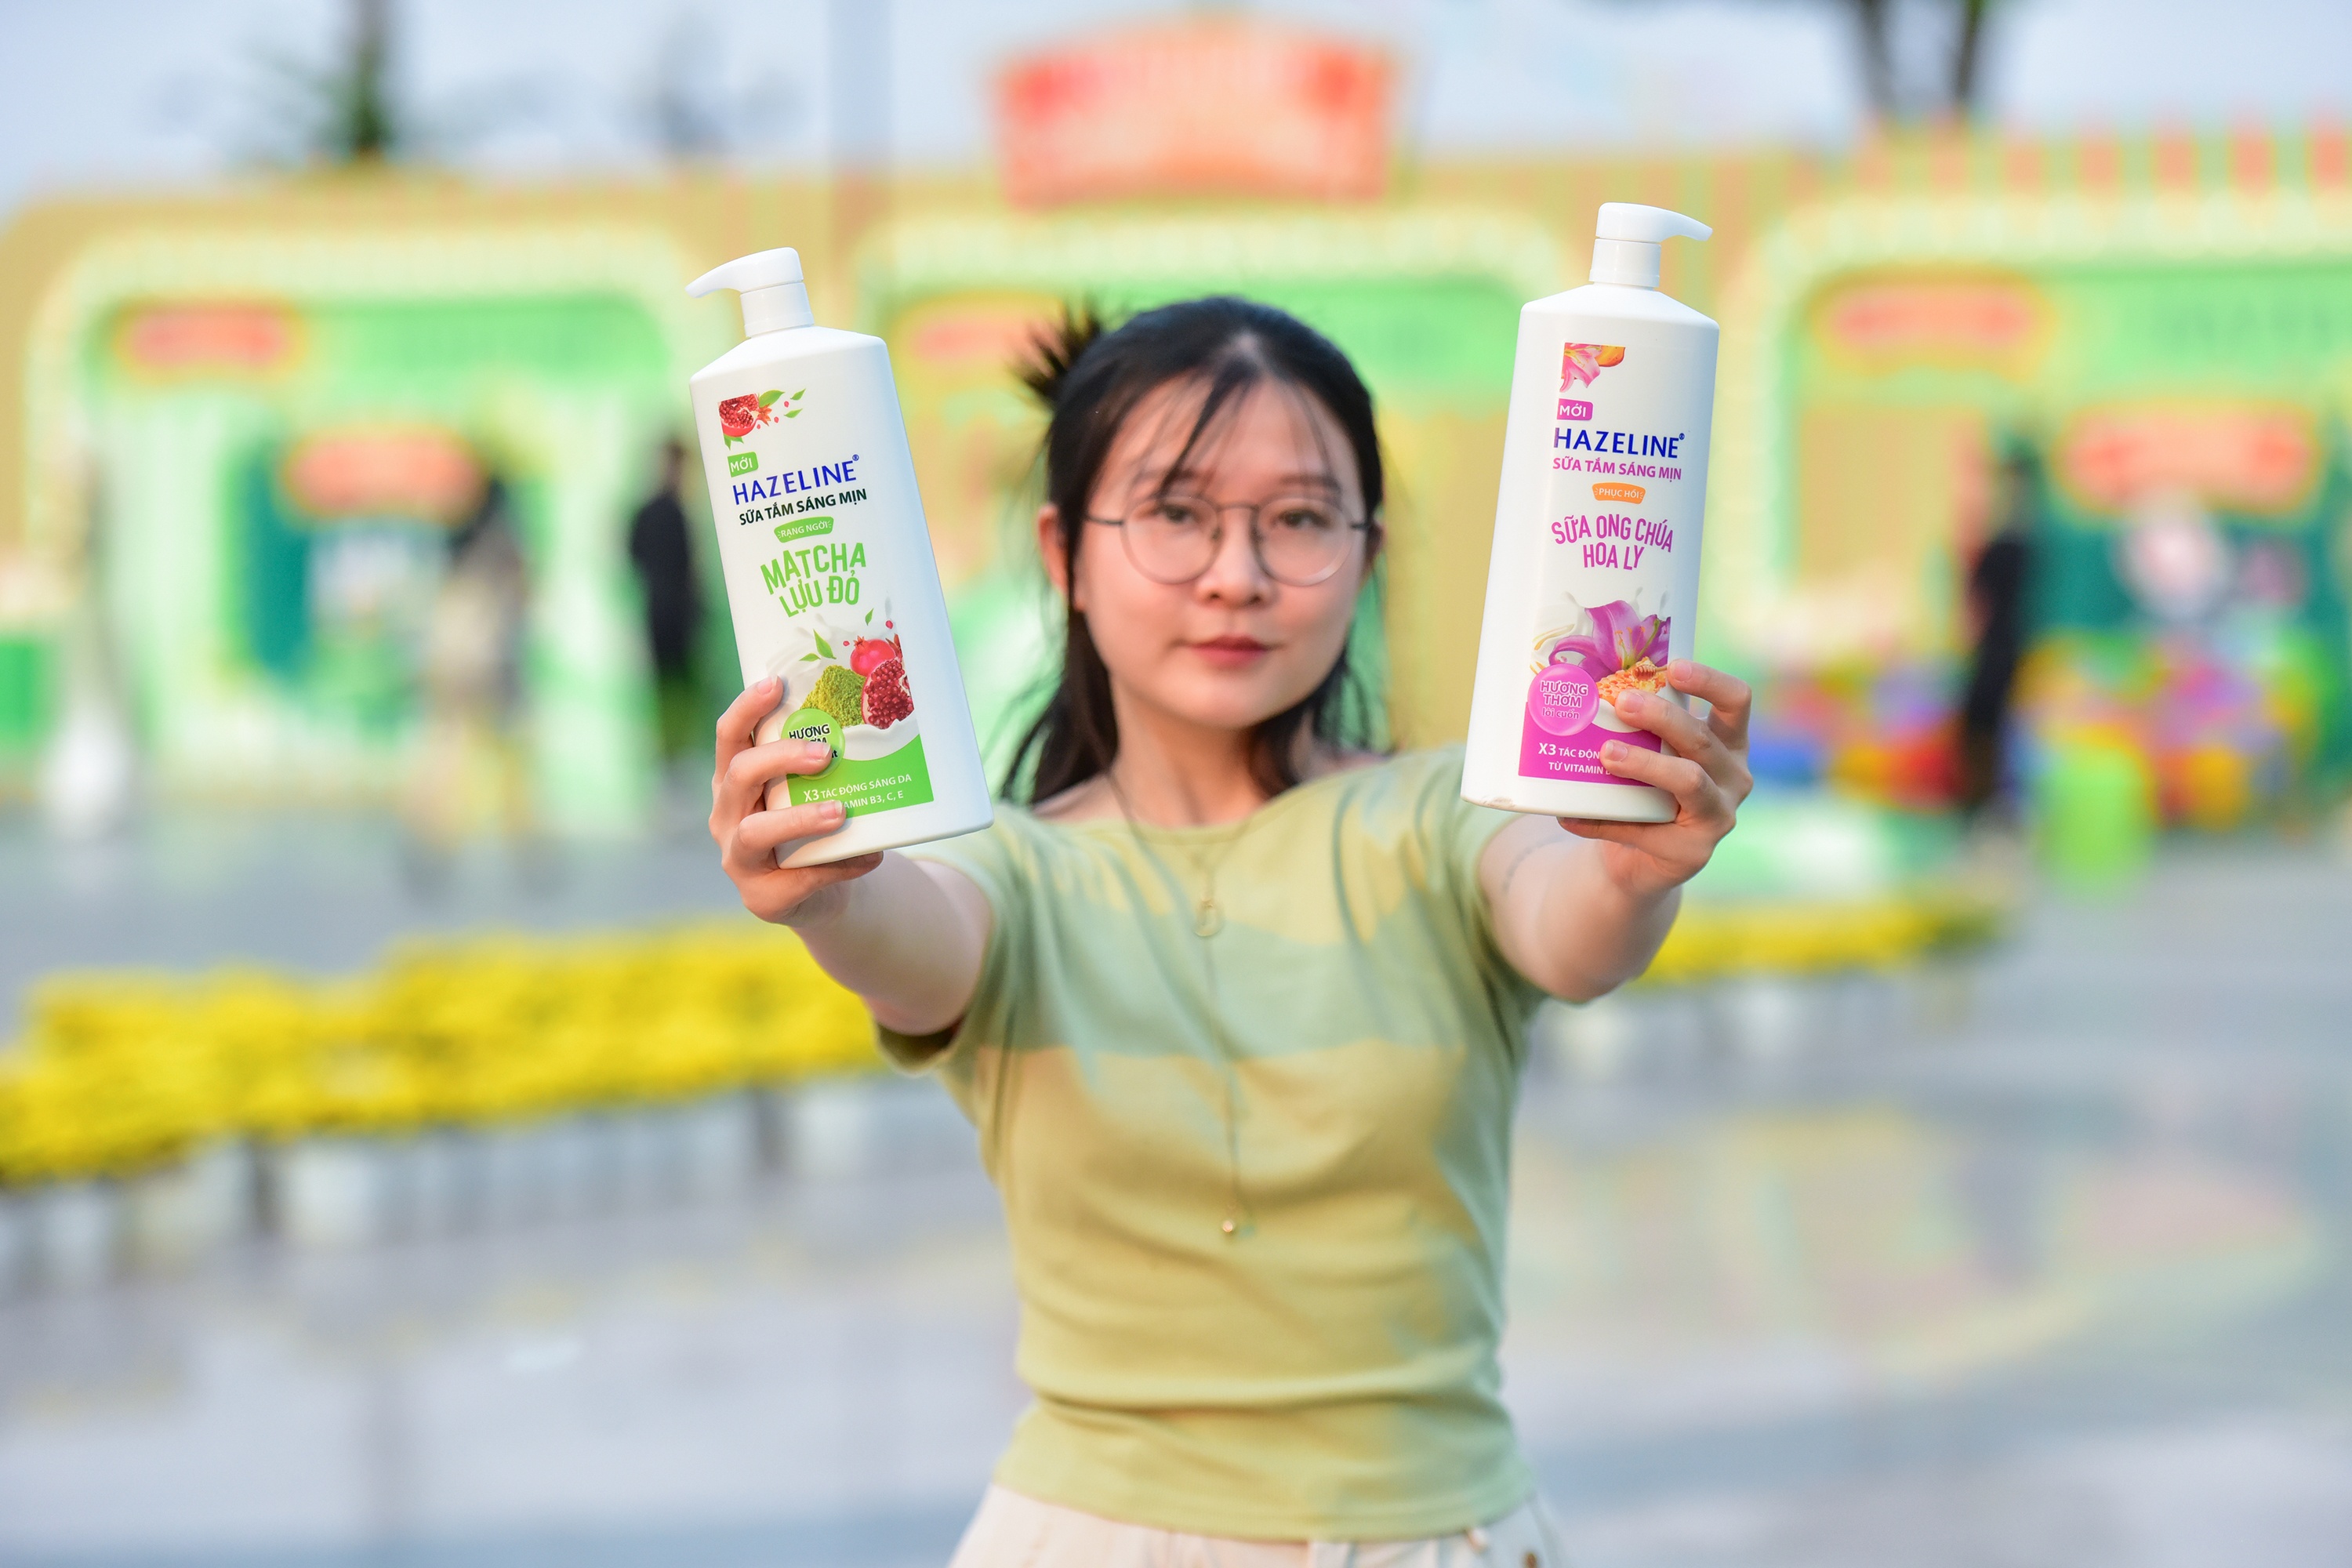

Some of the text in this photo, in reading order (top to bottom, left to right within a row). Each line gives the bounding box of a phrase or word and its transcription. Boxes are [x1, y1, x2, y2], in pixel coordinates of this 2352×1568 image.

[1559, 403, 1586, 417] MỚI
[731, 457, 753, 472] MỚI
[1553, 456, 1682, 482] SỮA TẮM SÁNG MỊN
[1599, 488, 1623, 498] PHỤC
[739, 488, 868, 525] SỮA TẮM SÁNG MỊN
[781, 526, 804, 539] RẠNG
[1552, 514, 1673, 553] SỮA ONG CHÚA
[1583, 542, 1645, 571] HOA LY
[760, 543, 866, 595] MATCHA
[779, 569, 859, 618] LỰU ĐỎ
[1540, 681, 1588, 696] HƯƠNG
[1543, 693, 1582, 708] THƠM
[789, 724, 830, 739] HƯƠNG
[1538, 742, 1599, 760] X3 TÁC ĐỘN
[1548, 760, 1563, 771] TỪ
[1563, 763, 1603, 775] VITAMIN
[804, 774, 912, 802] X3 TÁC ĐỘNG SÁNG DA
[844, 797, 868, 809] AMIN
[869, 795, 884, 804] B3,
[887, 793, 895, 801] C,
